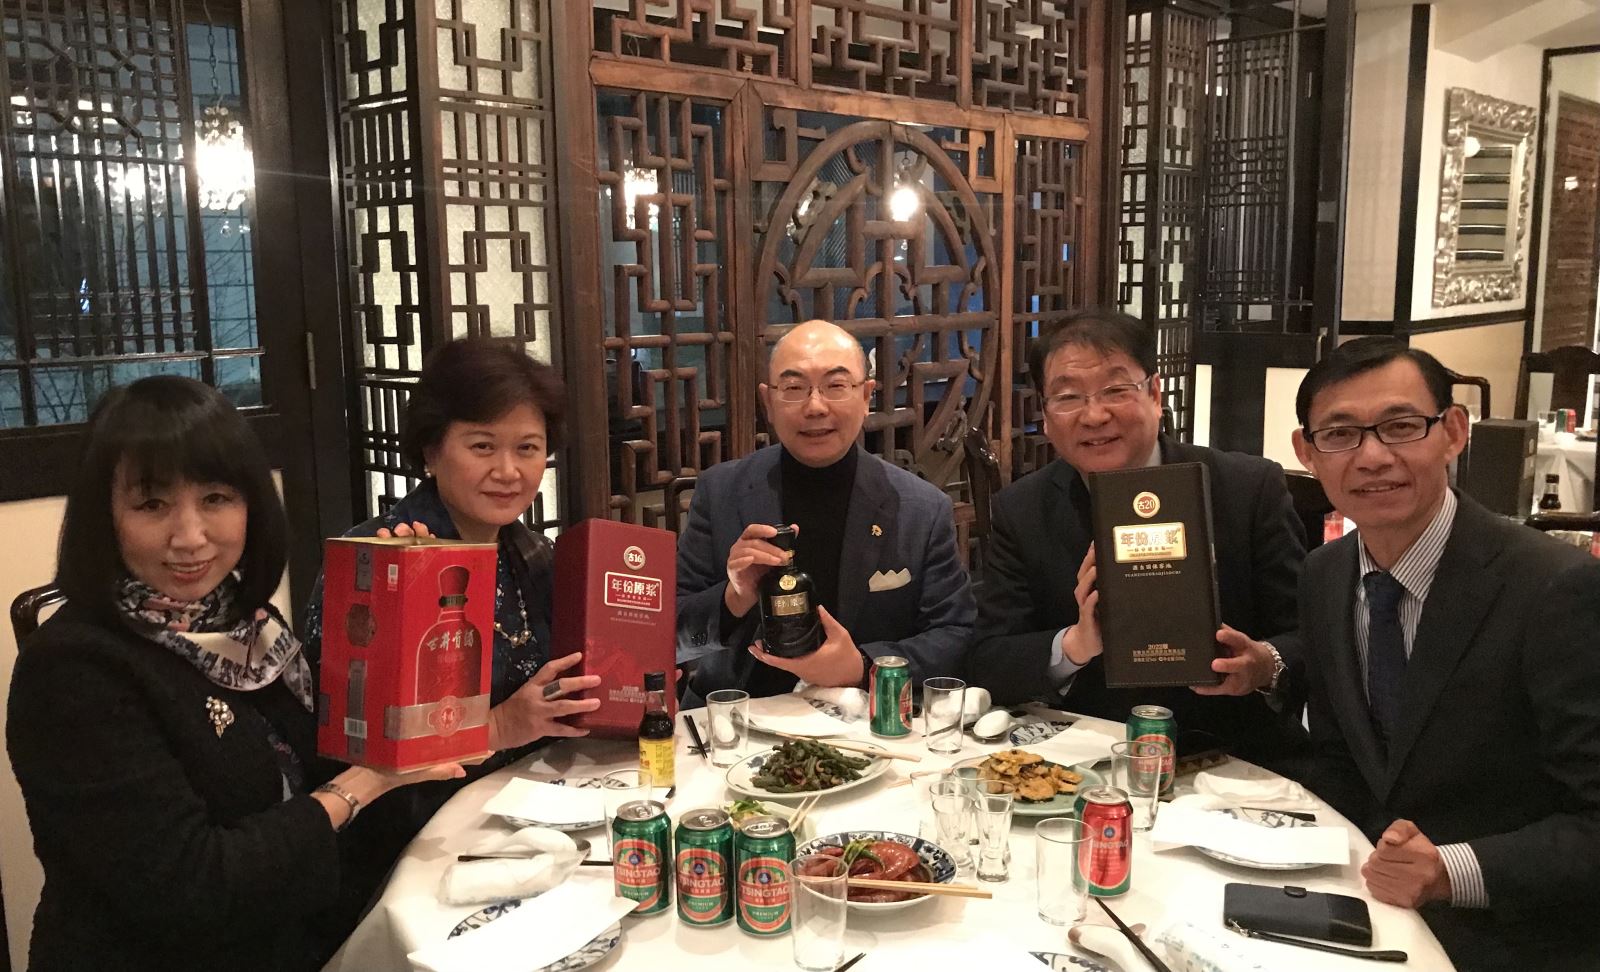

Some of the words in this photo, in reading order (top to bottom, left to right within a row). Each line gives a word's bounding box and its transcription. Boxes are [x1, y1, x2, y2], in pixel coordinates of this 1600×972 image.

[1137, 500, 1156, 510] 古20
[628, 552, 643, 563] 古16
[611, 578, 657, 597] 年份原浆
[616, 866, 660, 878] TSINGTAO
[680, 875, 725, 888] TSINGTAO
[742, 885, 789, 897] TSINGTAO
